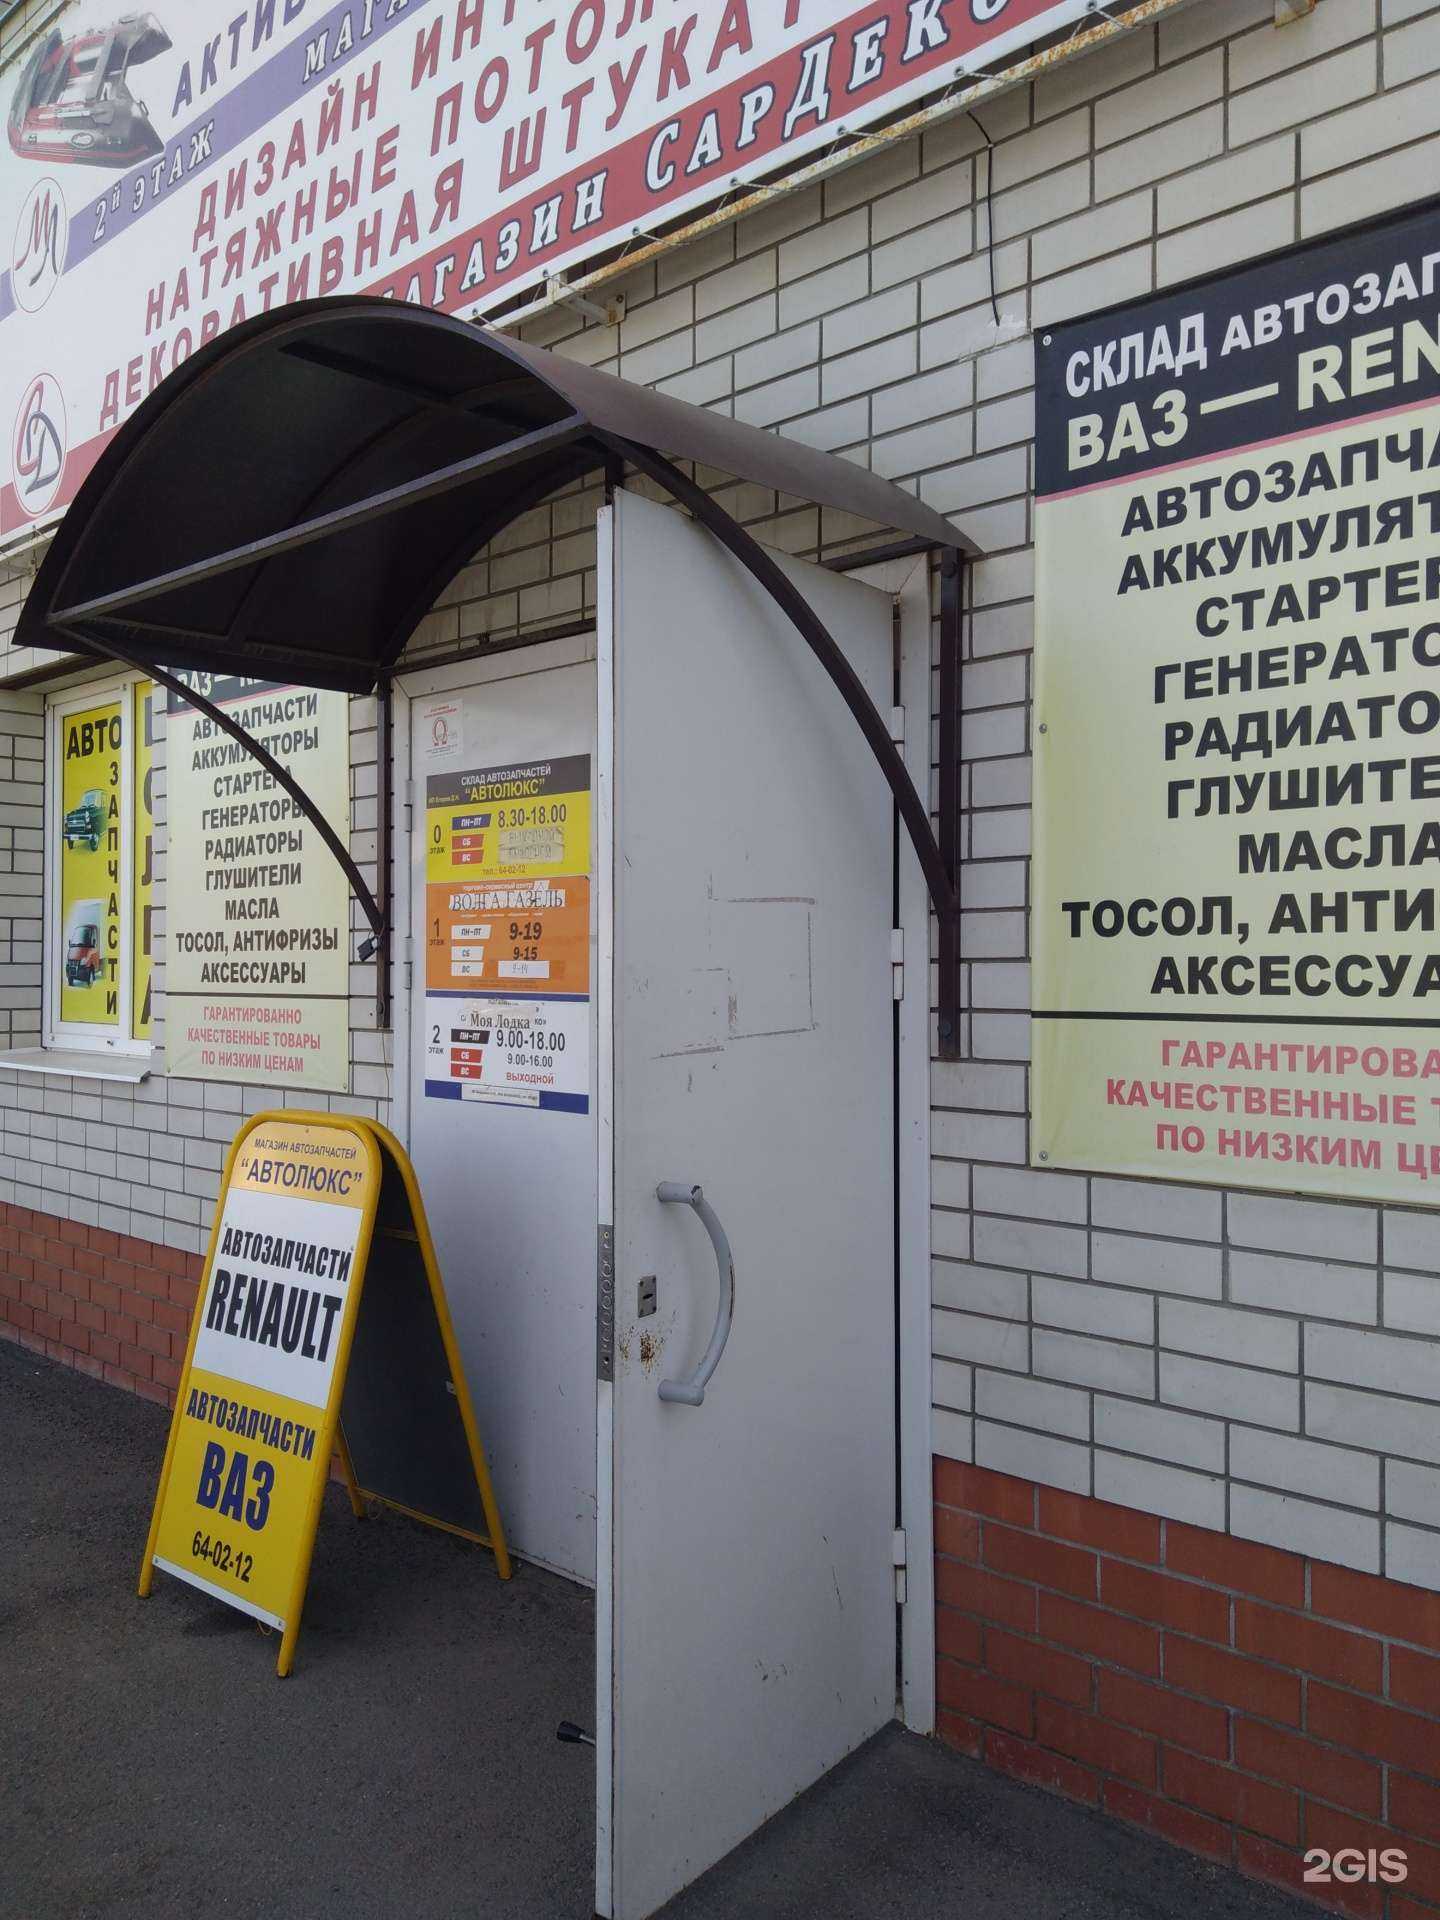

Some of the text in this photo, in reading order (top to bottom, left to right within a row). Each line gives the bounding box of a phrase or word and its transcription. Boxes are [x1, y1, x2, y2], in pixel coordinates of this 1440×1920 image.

[132, 118, 215, 213] ЭТАЖ
[193, 60, 381, 253] ДИЗАЙН
[145, 124, 400, 336] НАТЯЖНЫЕ
[381, 168, 608, 308] АГАЗИН
[99, 158, 464, 432] ДЕКОРАТИВНАЯ
[1066, 313, 1207, 398] СКЛАД
[1068, 389, 1189, 471] ВАЗ
[66, 714, 121, 760] АВТО
[1164, 690, 1440, 761] РАДИАТО
[192, 727, 319, 771] АККУМУЯТОРЫ
[461, 763, 551, 786] СКЛАД АВТОЗАПЧАСТЕЙ
[1168, 755, 1440, 818] ГЛУШИТЕ
[202, 798, 306, 830] ГЕНЕРАТОРЫ
[498, 803, 567, 828] 8.30-18.00
[205, 829, 302, 862] РАДИАТОРЫ
[1239, 822, 1440, 874] МАСЛА
[206, 862, 301, 891] ГЛУШИТЕЛИ
[225, 897, 280, 920] МАСЛА
[510, 922, 542, 940] 9-19
[1062, 895, 1250, 945] ТОСОЛ,
[176, 928, 338, 956] ТОСОЛ, АНТИФРИЗЫ
[513, 946, 537, 960] 9-15
[201, 962, 305, 983] АКСЕССУАРЫ
[203, 1006, 302, 1024] ГАРАНТИРОВАННО
[433, 1025, 440, 1043] 2
[496, 1030, 566, 1051] 9.00-18.00
[495, 1014, 530, 1030] Лодка
[187, 1027, 321, 1050] КАЧЕСТВЕННЫЕ ТОВАРЫ
[201, 1050, 304, 1072] ПО НИЗКИМ ЦЕНАМ
[507, 1053, 553, 1067] 9.00-16.00
[1107, 1079, 1416, 1125] КАЧЕСТВЕННЫЕ
[255, 1137, 357, 1160] МАГАЗИН АВТОЗАПЧАСТЕЙ
[1156, 1123, 1205, 1154] ПО
[1218, 1127, 1382, 1170] НИЗКИМ
[220, 1227, 352, 1283] АВТОЗАПЧАСТИ
[205, 1268, 342, 1363] RENAULT
[186, 1388, 315, 1462] АВТОЗАПЧАСТИ
[195, 1440, 275, 1531] ВАЗ
[192, 1531, 254, 1583] 64-02-12
